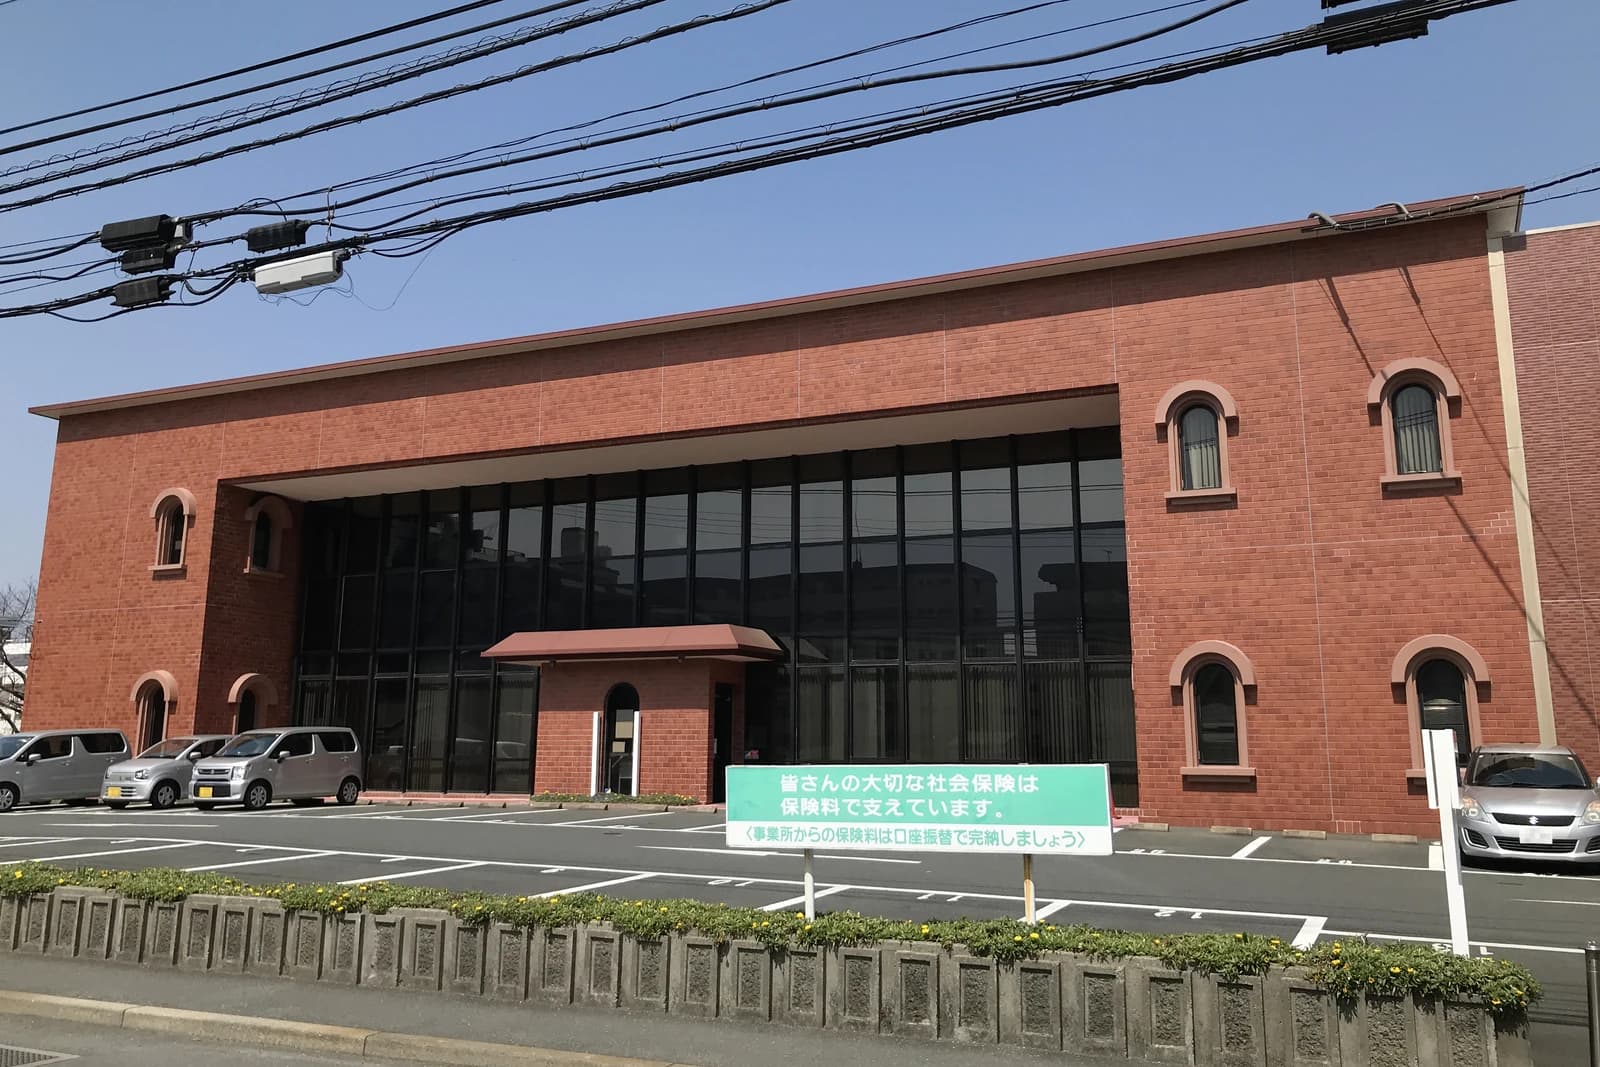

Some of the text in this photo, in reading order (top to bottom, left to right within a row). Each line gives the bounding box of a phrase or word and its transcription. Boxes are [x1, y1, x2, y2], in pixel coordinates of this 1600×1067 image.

[780, 773, 1039, 793] 皆さんの大切な社会保険は
[780, 798, 1003, 817] 保険料で支えています。
